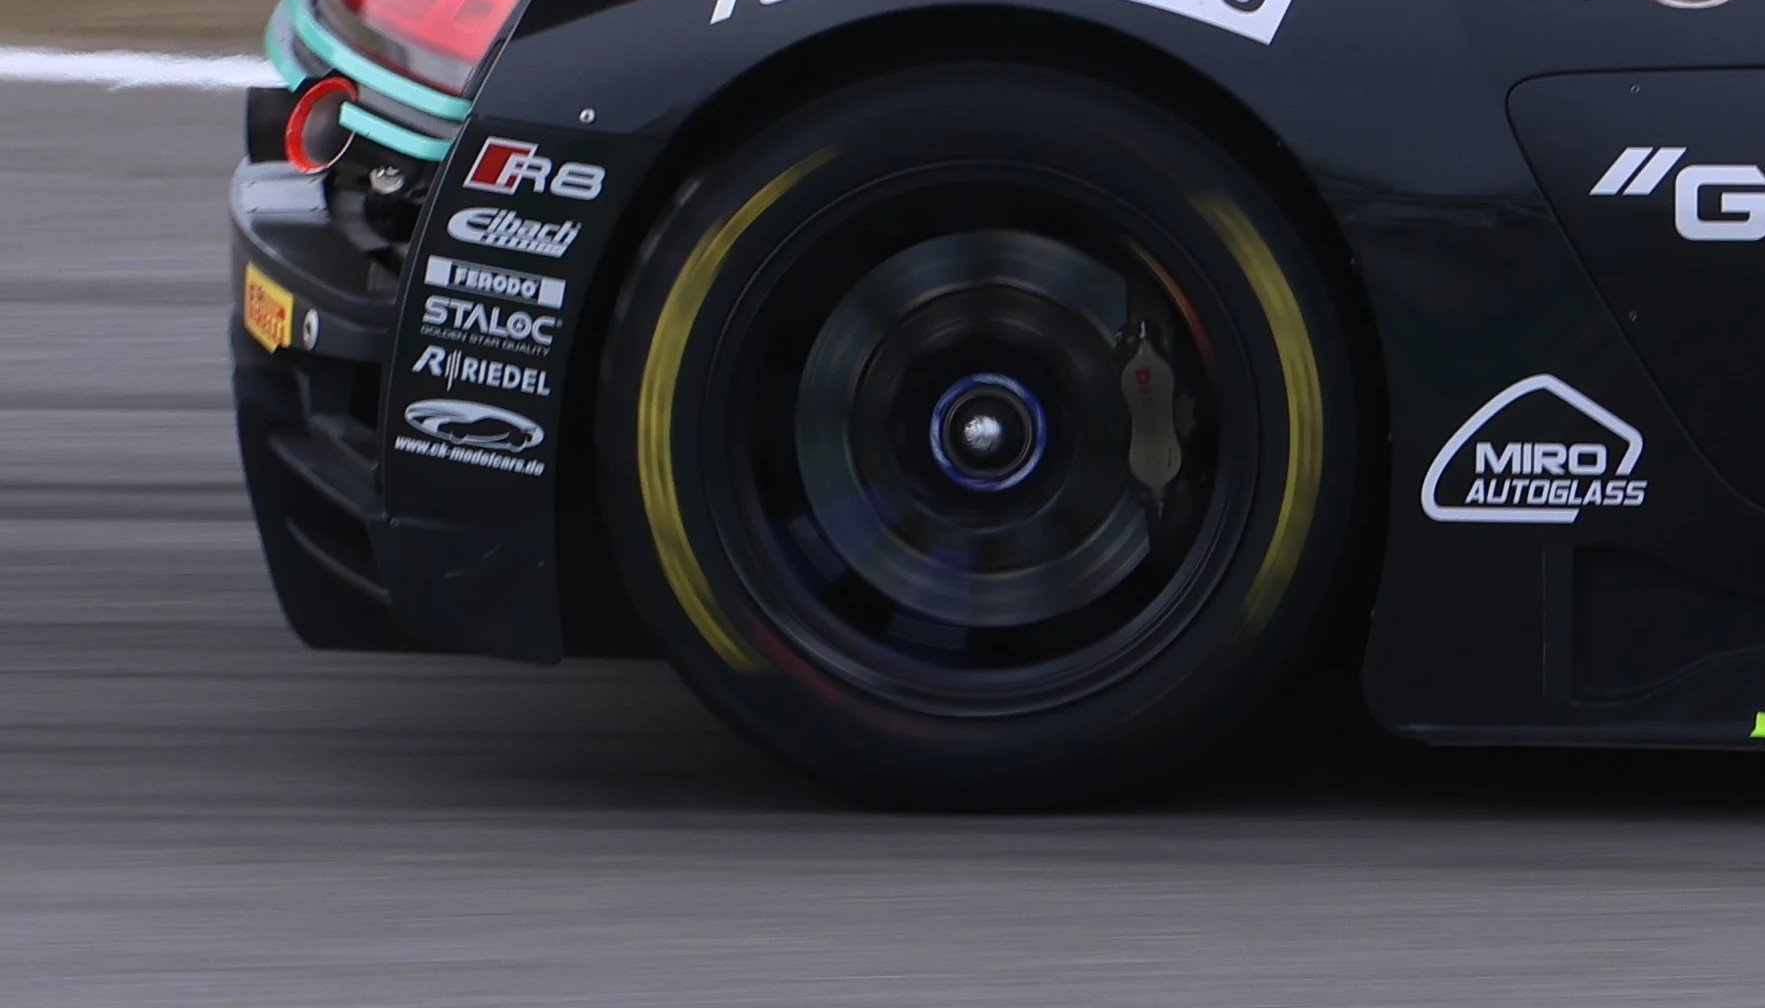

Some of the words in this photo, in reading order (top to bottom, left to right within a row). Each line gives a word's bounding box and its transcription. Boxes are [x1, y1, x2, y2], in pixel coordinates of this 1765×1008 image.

[494, 150, 606, 201] R8
[452, 265, 541, 300] FERODO
[460, 355, 551, 397] RIEDEL
[1474, 441, 1608, 476] MIRO
[1465, 478, 1649, 508] AUTOGLASS
